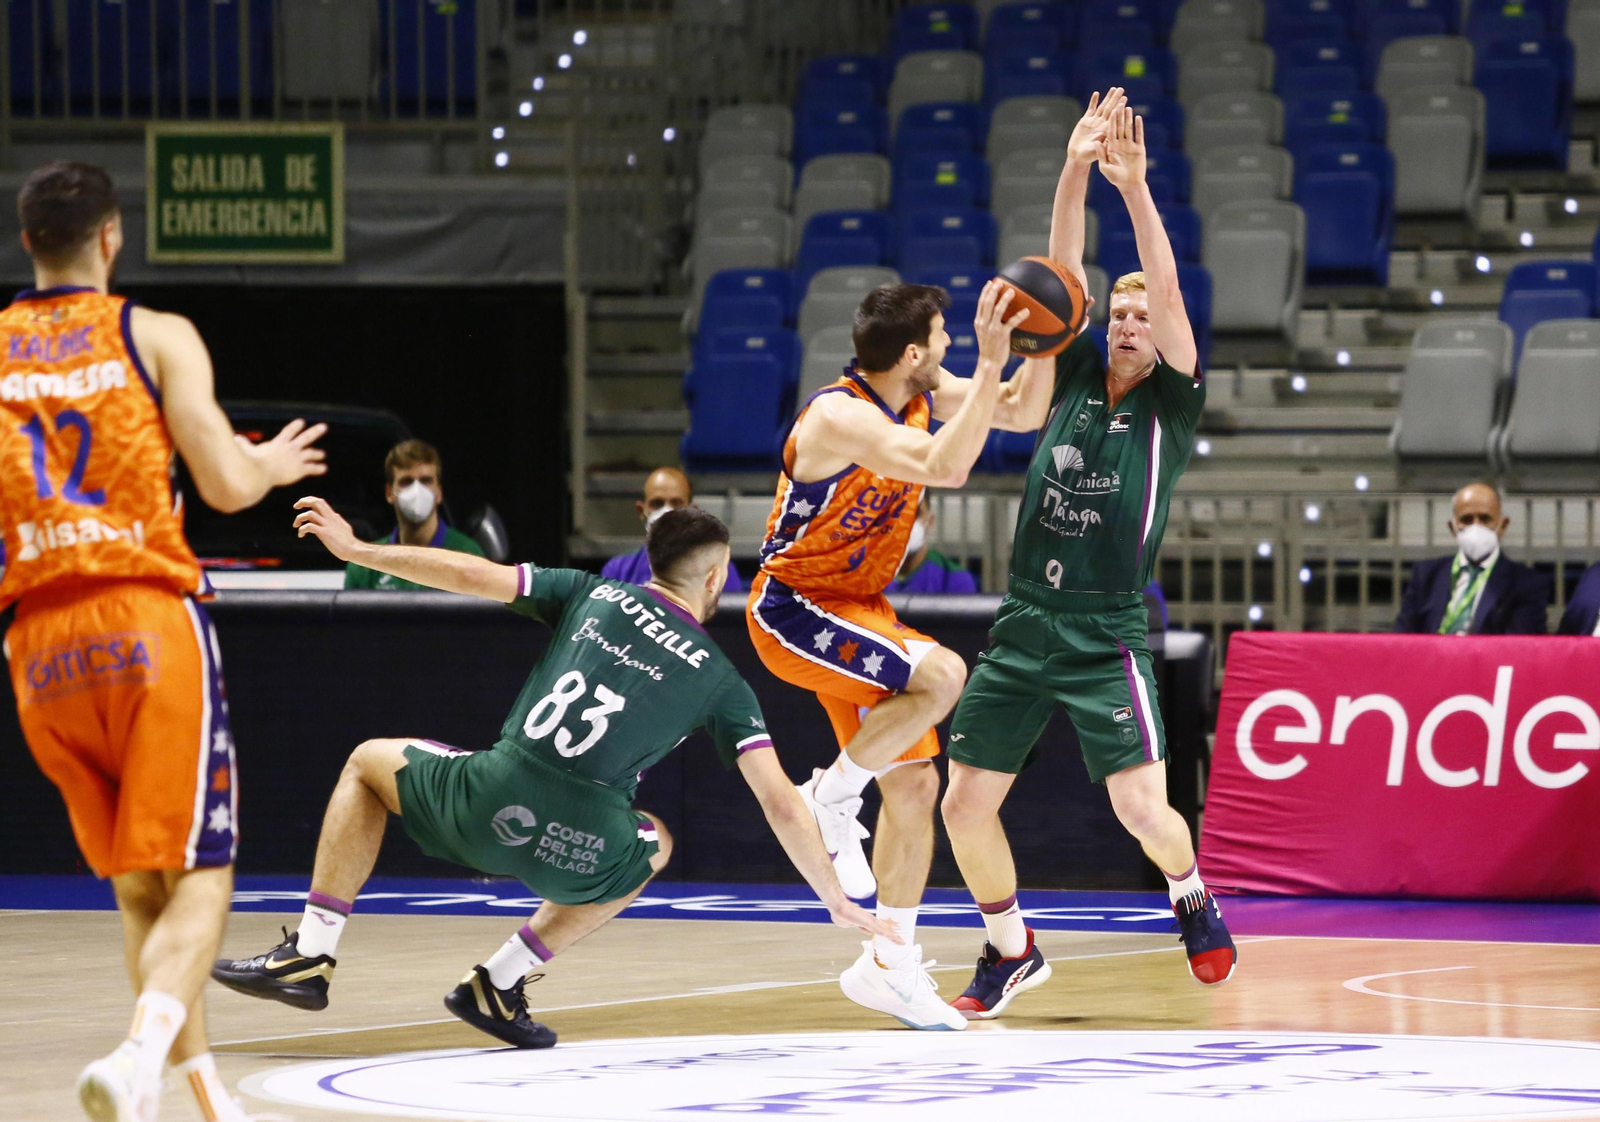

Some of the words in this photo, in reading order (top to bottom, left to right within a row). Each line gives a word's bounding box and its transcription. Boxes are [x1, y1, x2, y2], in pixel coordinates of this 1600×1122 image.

[171, 153, 265, 192] SALIDA
[285, 153, 317, 192] DE
[161, 200, 327, 236] EMERGENCIA
[0, 360, 127, 401] AMESA
[19, 409, 106, 507] 12
[1076, 471, 1120, 489] nicaa
[1043, 487, 1103, 533] Máaga
[1045, 559, 1064, 589] 9
[588, 584, 710, 669] BOUTEILLE
[523, 670, 626, 758] 83
[539, 835, 568, 857] DEL
[570, 848, 599, 865] SOL
[546, 822, 605, 852] COSTA
[533, 848, 595, 875] MÁLAGA
[648, 1041, 1384, 1116] PEDRIZAS
